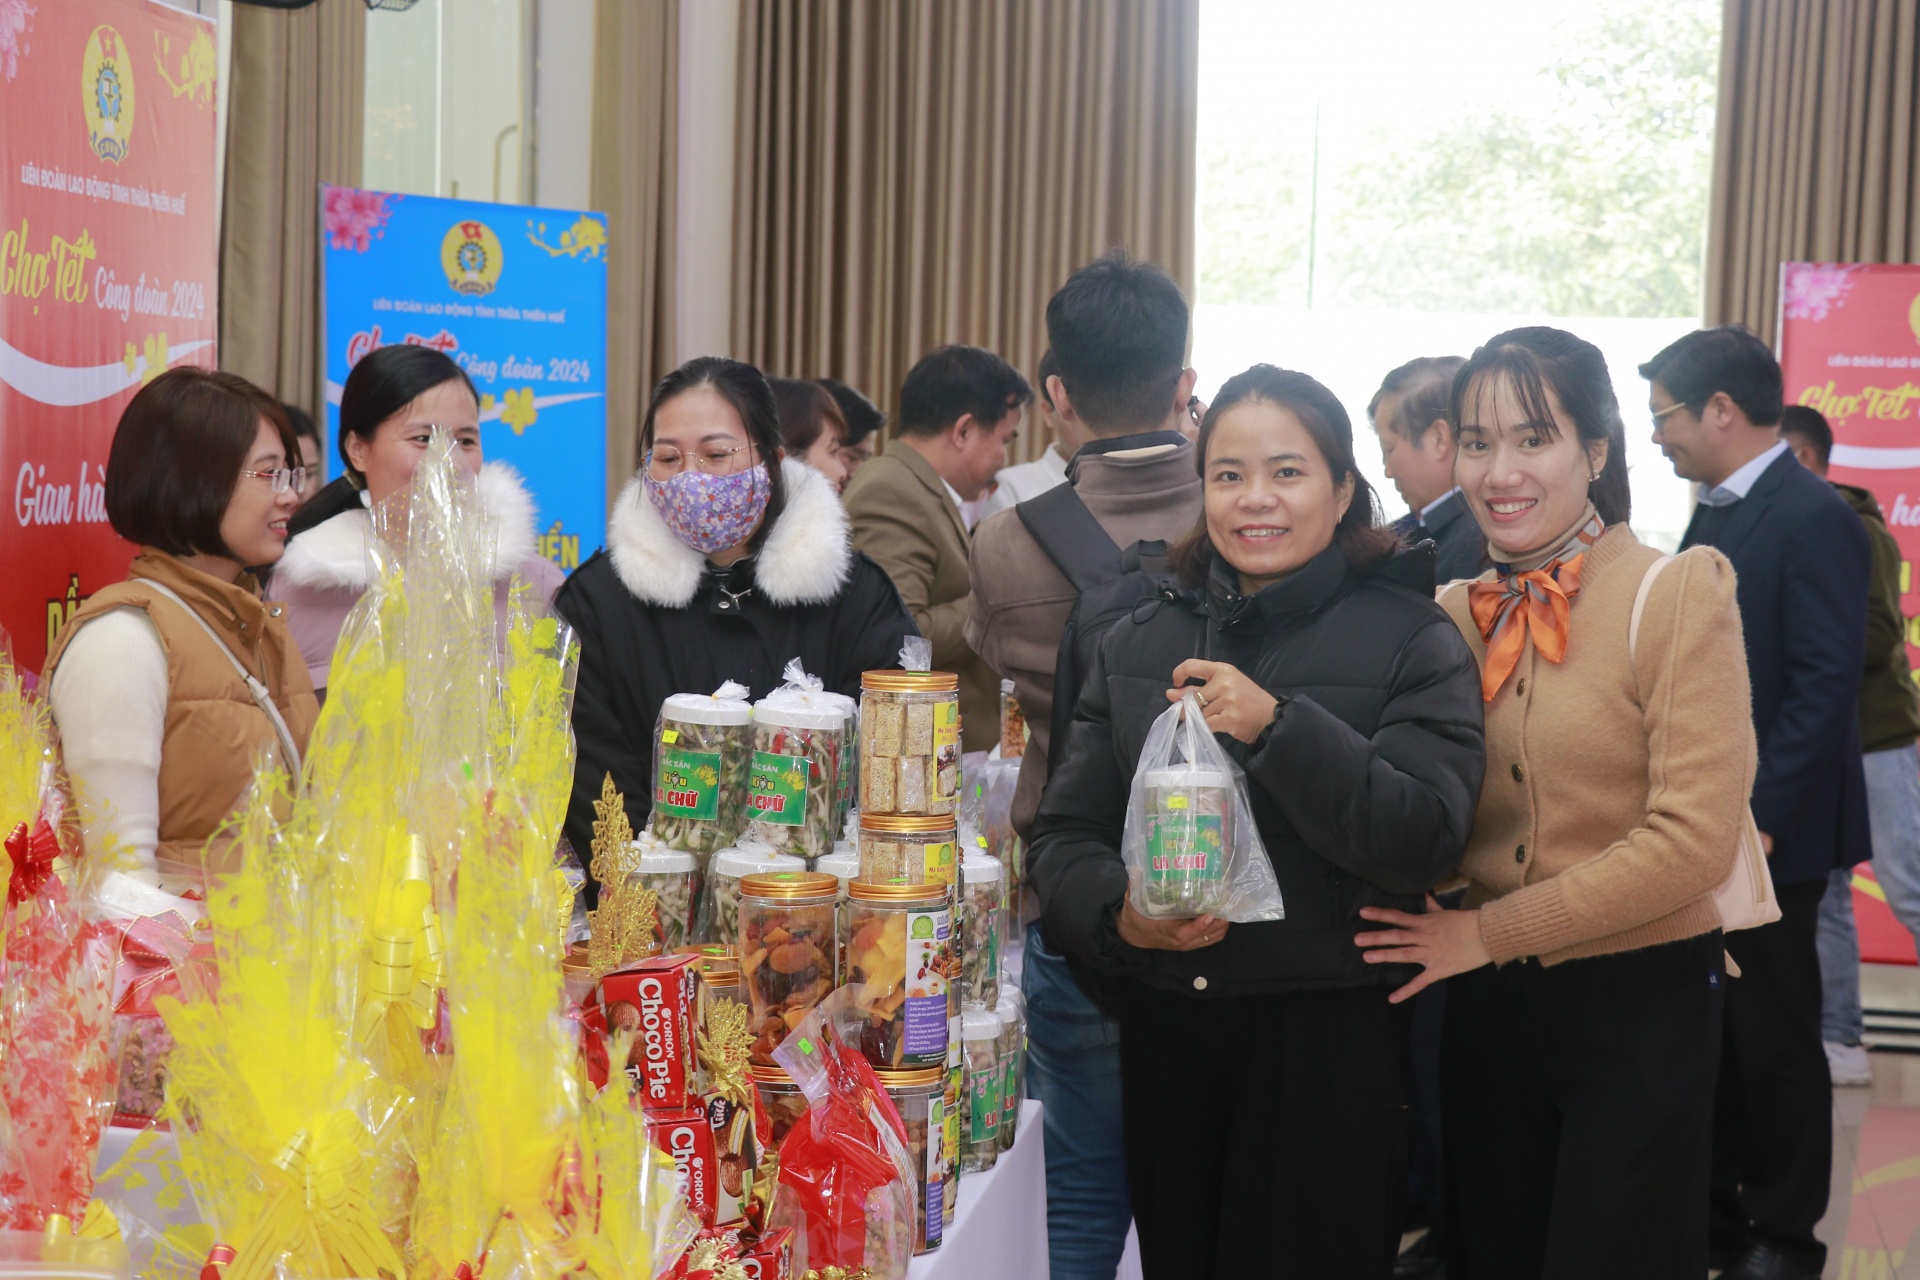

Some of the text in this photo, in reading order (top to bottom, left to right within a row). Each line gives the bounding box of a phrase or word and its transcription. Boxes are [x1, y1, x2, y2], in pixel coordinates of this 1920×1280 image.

[22, 161, 39, 185] LIÊN
[41, 167, 67, 191] ĐOÀN
[68, 174, 84, 195] LAO
[86, 175, 110, 202] ĐỘNG
[0, 218, 96, 316] Chợ Tết
[94, 266, 205, 322] Công đoàn 2024
[372, 297, 392, 311] LIÊN
[394, 299, 422, 313] ĐOÀN
[424, 302, 444, 315] LAO
[502, 354, 545, 380] đoàn
[547, 358, 590, 383] 2024
[1798, 380, 1920, 427] Chợ Tết
[15, 461, 111, 527] Gian hà
[667, 789, 699, 808] CHỮ
[755, 793, 787, 813] CHỮ
[1153, 855, 1170, 870] LA
[663, 1020, 674, 1058] ORION
[670, 1126, 695, 1207] Choc
